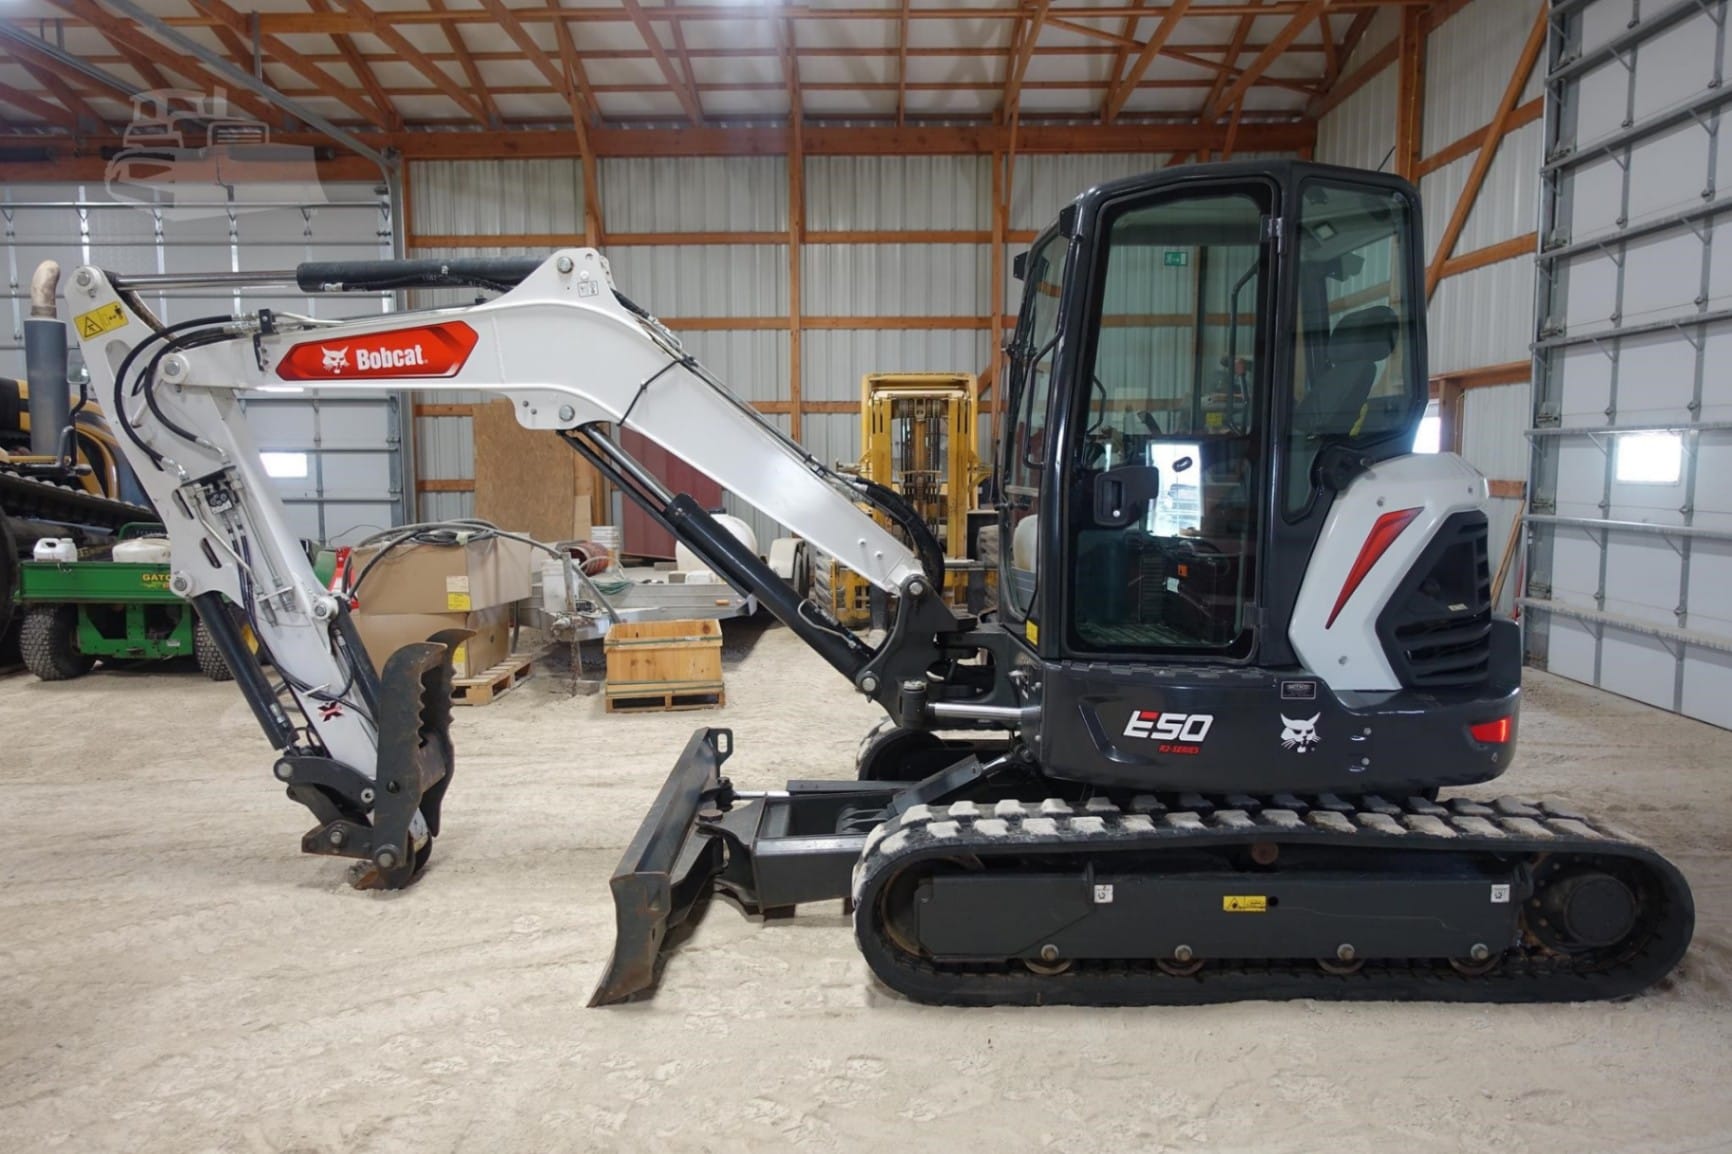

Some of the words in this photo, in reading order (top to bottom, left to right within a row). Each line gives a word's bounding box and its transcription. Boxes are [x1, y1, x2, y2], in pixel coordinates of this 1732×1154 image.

[356, 344, 424, 370] Bobcat
[142, 573, 171, 581] GATO
[1123, 710, 1214, 741] E50
